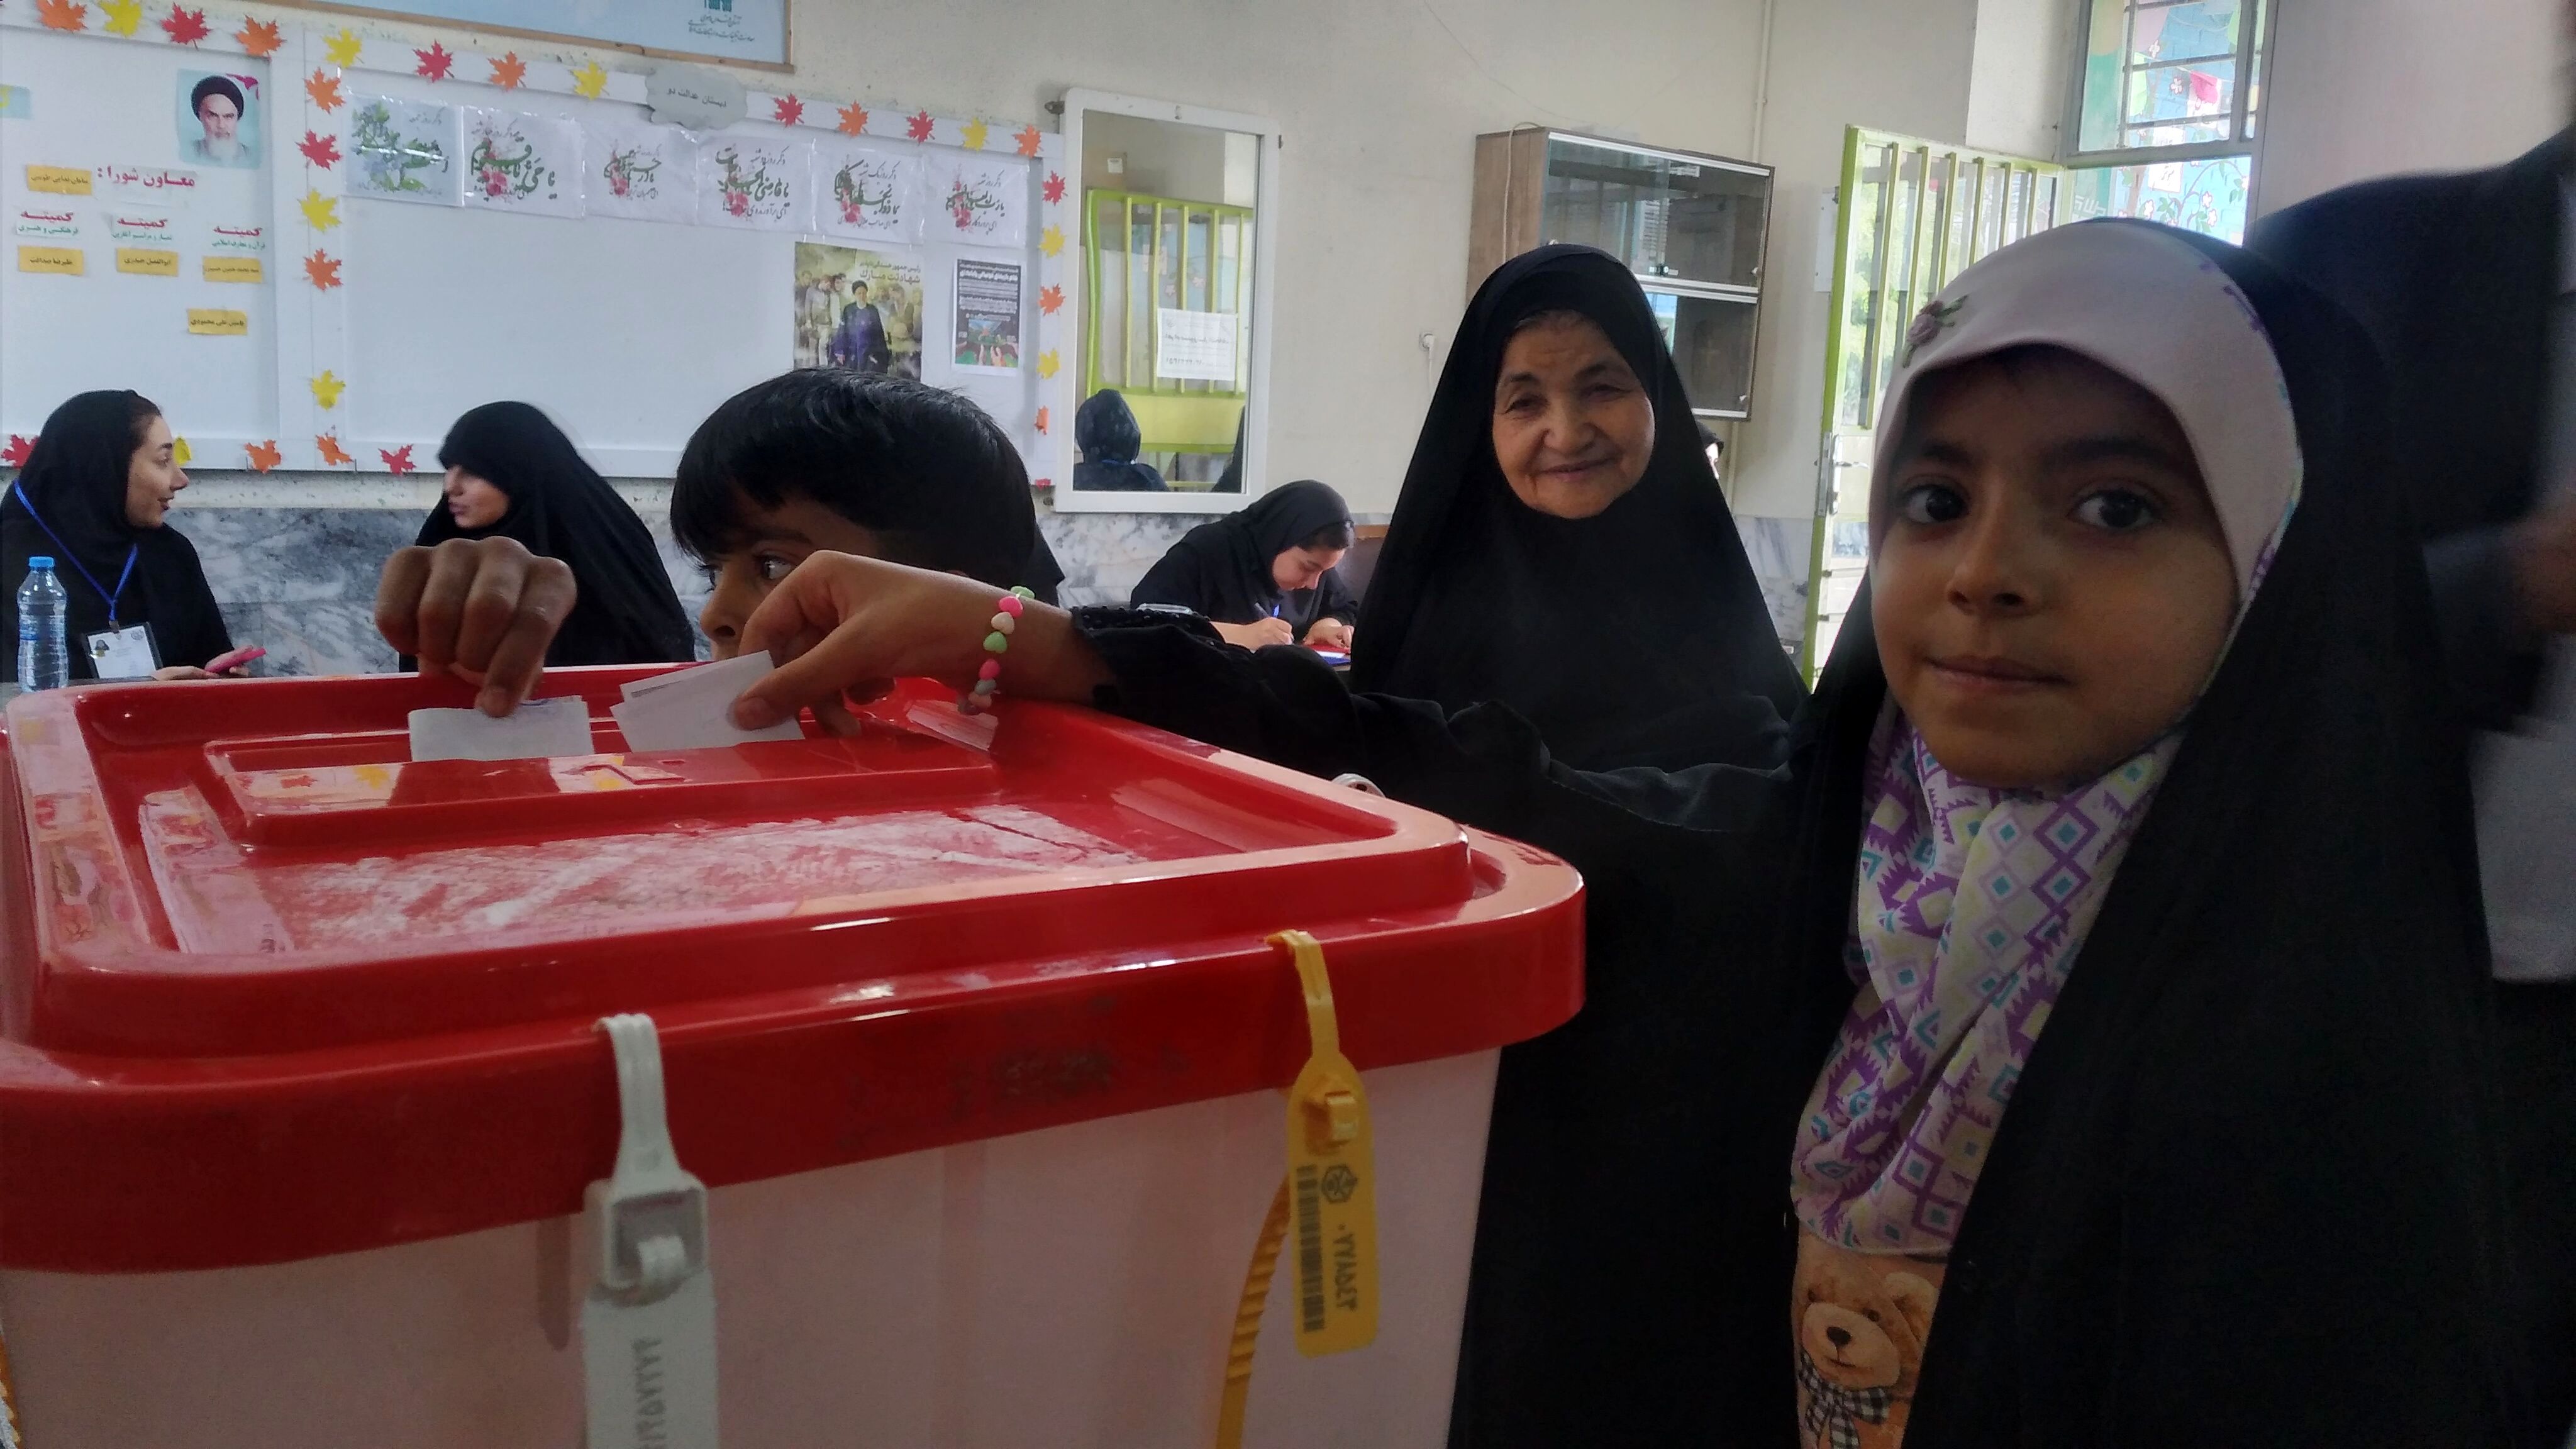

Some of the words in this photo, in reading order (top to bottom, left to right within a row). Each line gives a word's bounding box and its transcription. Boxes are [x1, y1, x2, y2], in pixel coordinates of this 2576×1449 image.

[143, 170, 194, 187] معاون
[21, 211, 74, 224] کمیته
[117, 218, 168, 229] کمیته
[213, 226, 262, 238] کمیته
